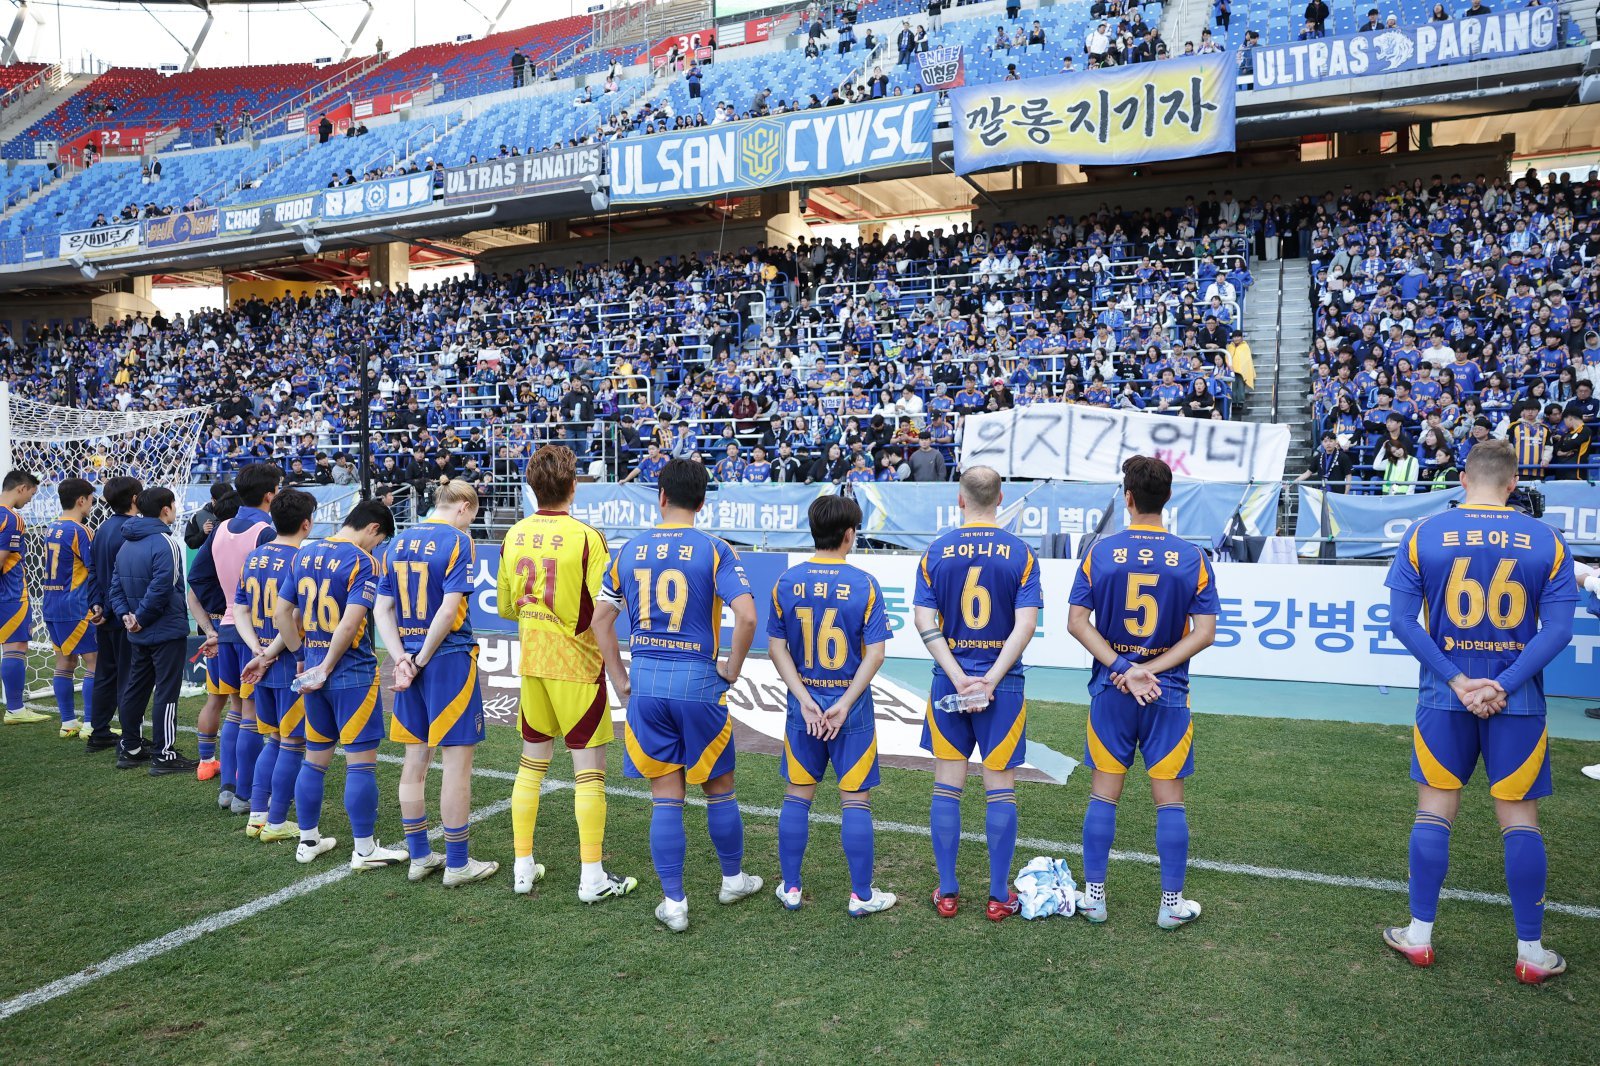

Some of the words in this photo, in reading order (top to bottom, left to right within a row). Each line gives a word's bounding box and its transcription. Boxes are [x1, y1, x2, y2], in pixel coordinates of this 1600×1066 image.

[678, 34, 701, 52] 30
[1256, 36, 1369, 87] ULTRAS
[1416, 6, 1554, 65] PARANG
[922, 62, 958, 84] 이청용
[101, 131, 120, 145] 32
[611, 131, 734, 196] ULSAN
[786, 99, 932, 172] CYWSC
[446, 162, 516, 194] ULTRAS
[523, 148, 599, 182] FANATICS
[225, 208, 260, 230] CAMA
[275, 198, 314, 222] RADA
[970, 404, 1139, 476] 의지가
[718, 500, 756, 528] 함께
[760, 504, 798, 529] 하리
[396, 540, 436, 555] 루빅손
[515, 534, 563, 550] 조현우
[636, 544, 693, 560] 김영권
[942, 542, 1010, 559] 보야니치
[1113, 548, 1179, 566] 정우영
[1442, 530, 1532, 549] 트로야크
[249, 556, 285, 571] 윤종규
[301, 556, 341, 572] 박민서
[246, 576, 280, 629] 24
[392, 560, 428, 620] 17
[516, 556, 557, 613] 21
[634, 568, 688, 632] 19
[793, 582, 850, 600] 이희균
[961, 566, 992, 630] 6
[1445, 557, 1527, 630] 66
[298, 576, 341, 633] 26
[1124, 572, 1160, 638] 5
[795, 607, 848, 670] 16
[1213, 598, 1414, 656] 동강병원
